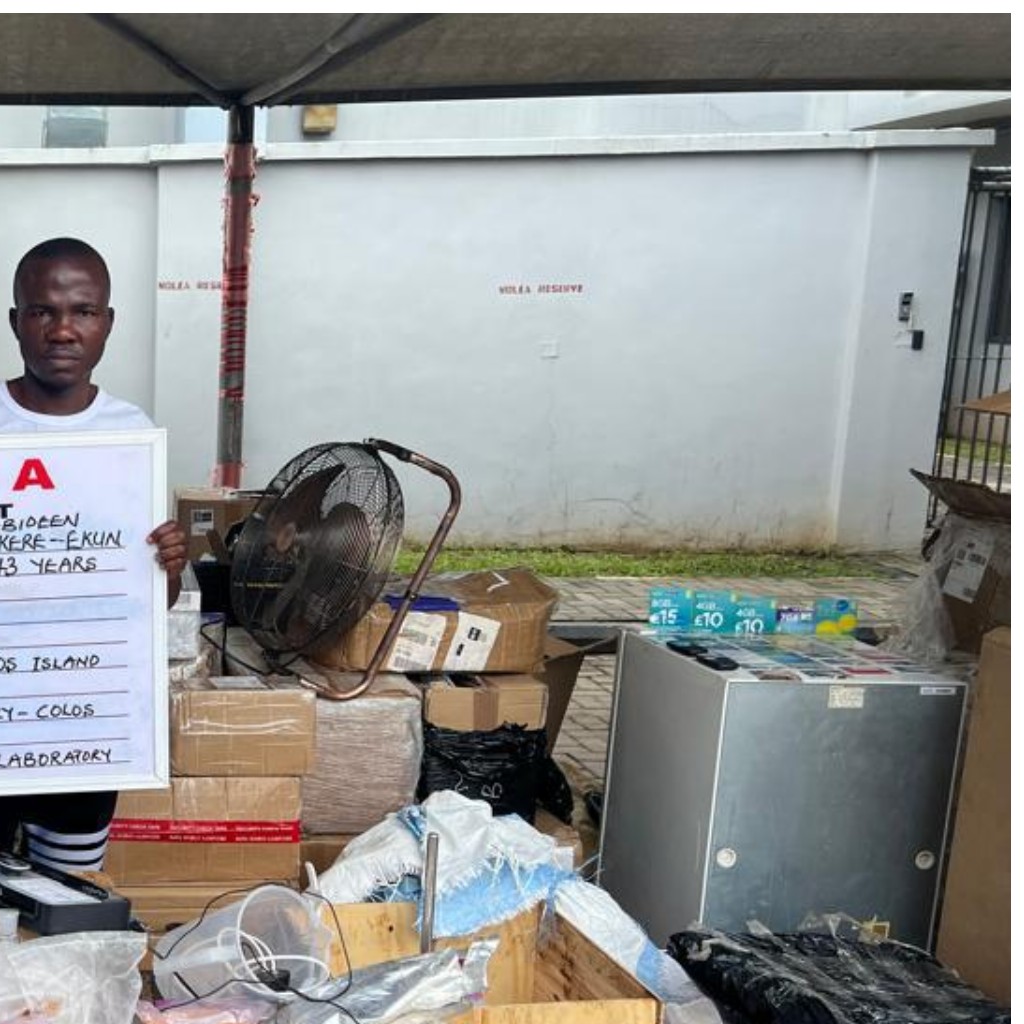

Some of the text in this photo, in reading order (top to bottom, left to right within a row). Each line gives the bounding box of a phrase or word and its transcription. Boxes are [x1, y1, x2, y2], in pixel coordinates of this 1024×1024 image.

[30, 556, 97, 574] YEARS
[694, 612, 724, 628] £10
[32, 655, 100, 673] ISLAND
